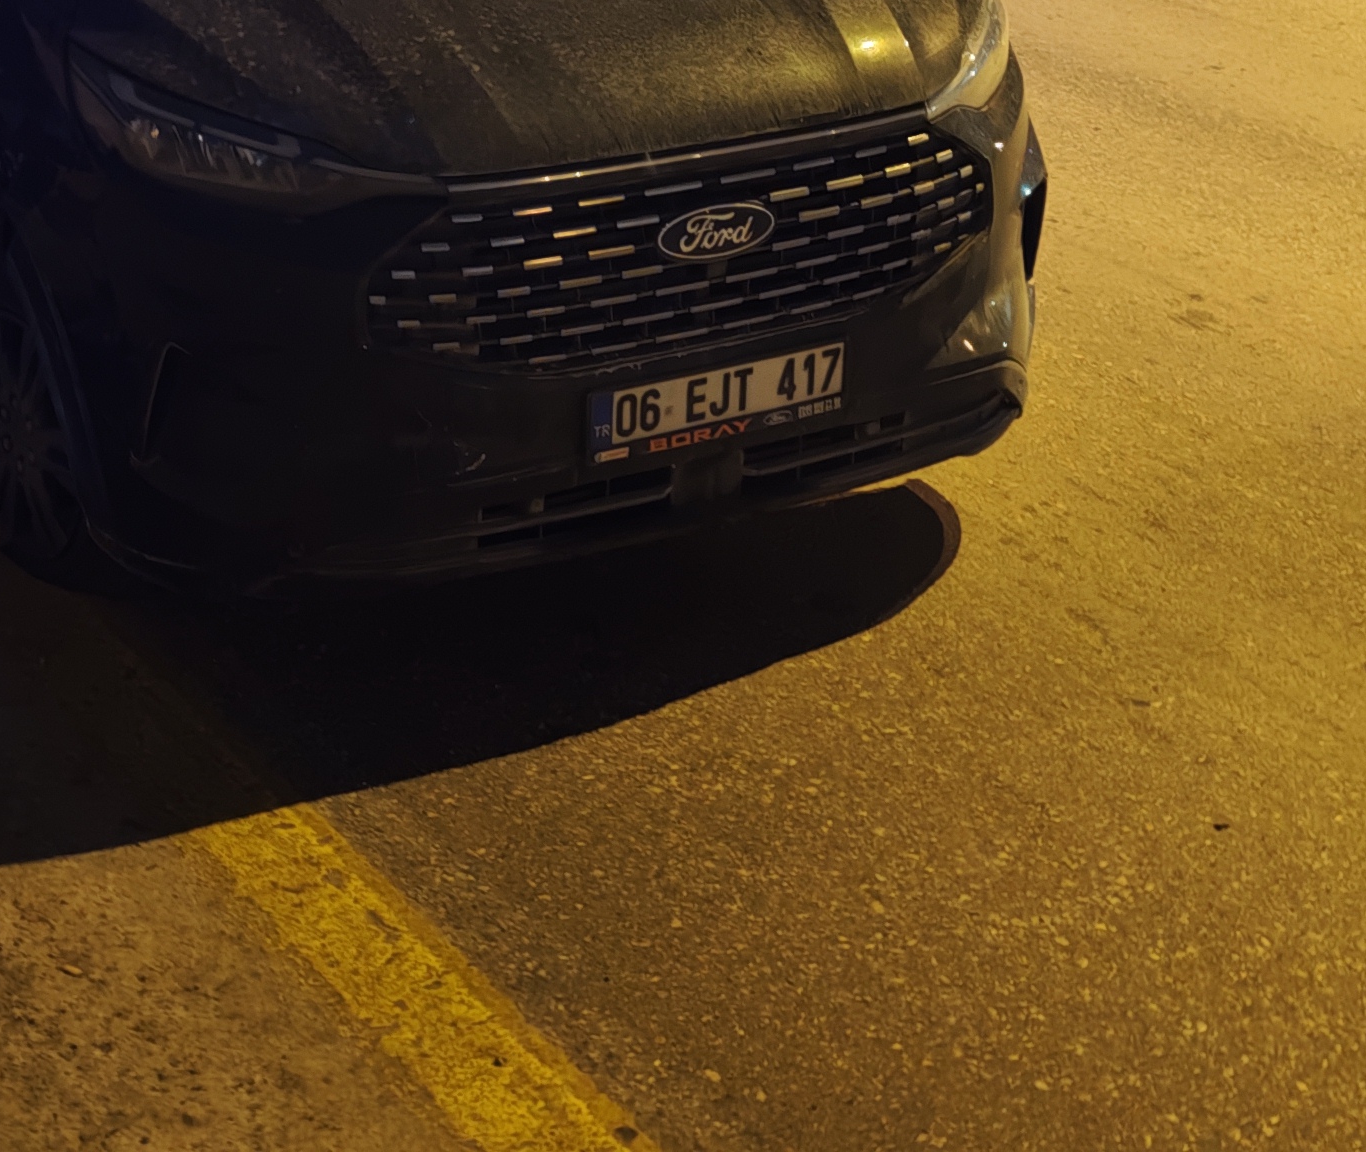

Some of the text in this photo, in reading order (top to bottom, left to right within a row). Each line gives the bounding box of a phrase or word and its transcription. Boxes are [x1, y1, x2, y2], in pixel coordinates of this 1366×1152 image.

[679, 211, 754, 253] Ford
[615, 388, 661, 438] 06
[686, 366, 754, 423] EJT
[776, 347, 842, 401] 417
[593, 423, 611, 439] TR
[647, 417, 753, 453] BORAY
